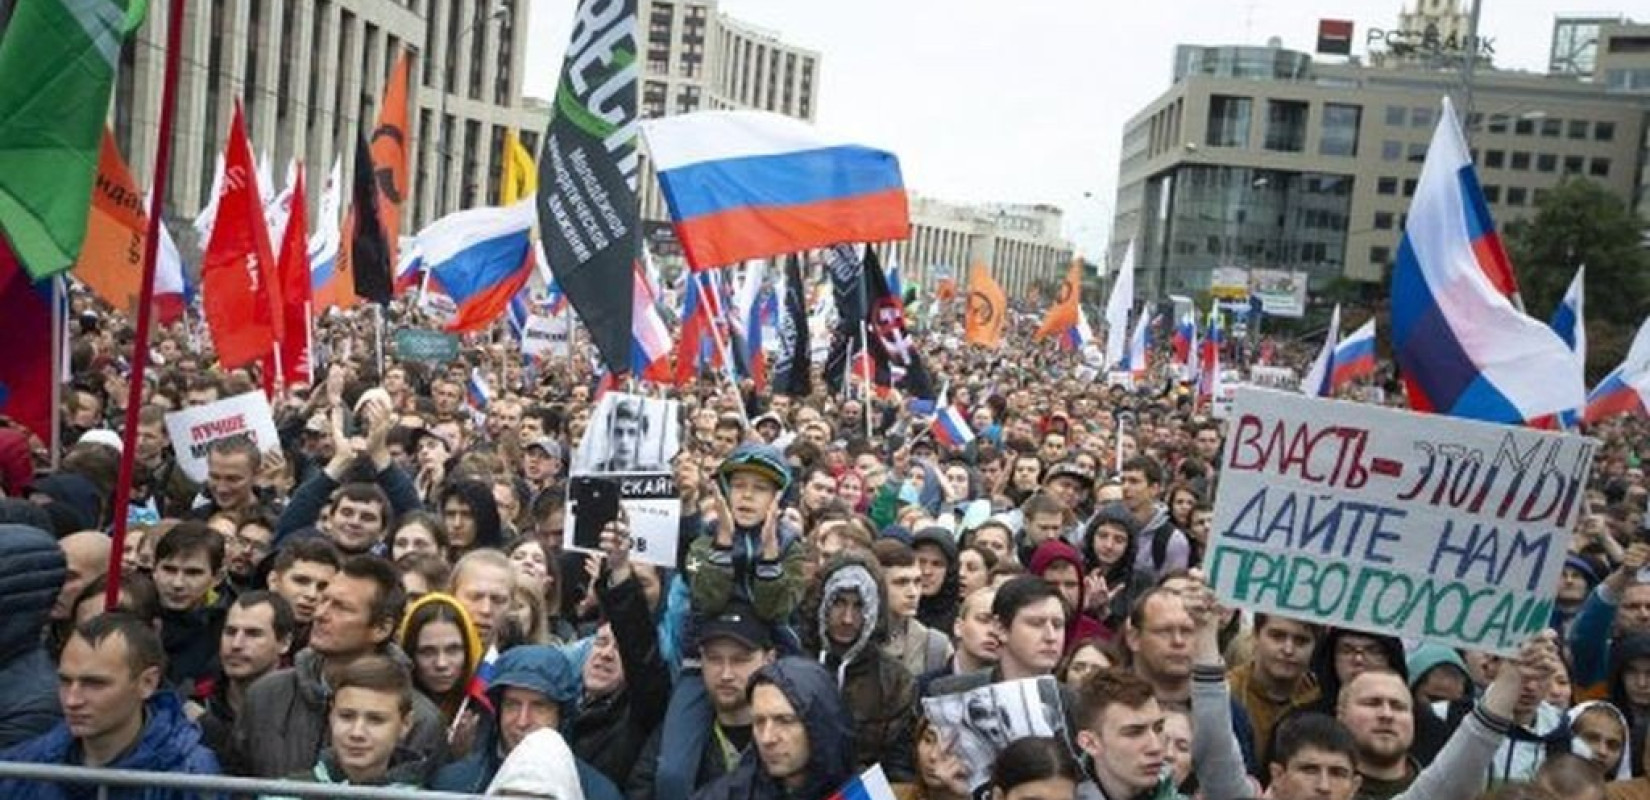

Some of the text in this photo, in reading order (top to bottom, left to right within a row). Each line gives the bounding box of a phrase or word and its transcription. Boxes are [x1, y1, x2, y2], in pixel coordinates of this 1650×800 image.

[191, 413, 247, 442] ЛУЧШЕ
[1230, 415, 1368, 489] ВЛАСТЬ
[1223, 487, 1552, 591] ДАЙТЕ НАМ
